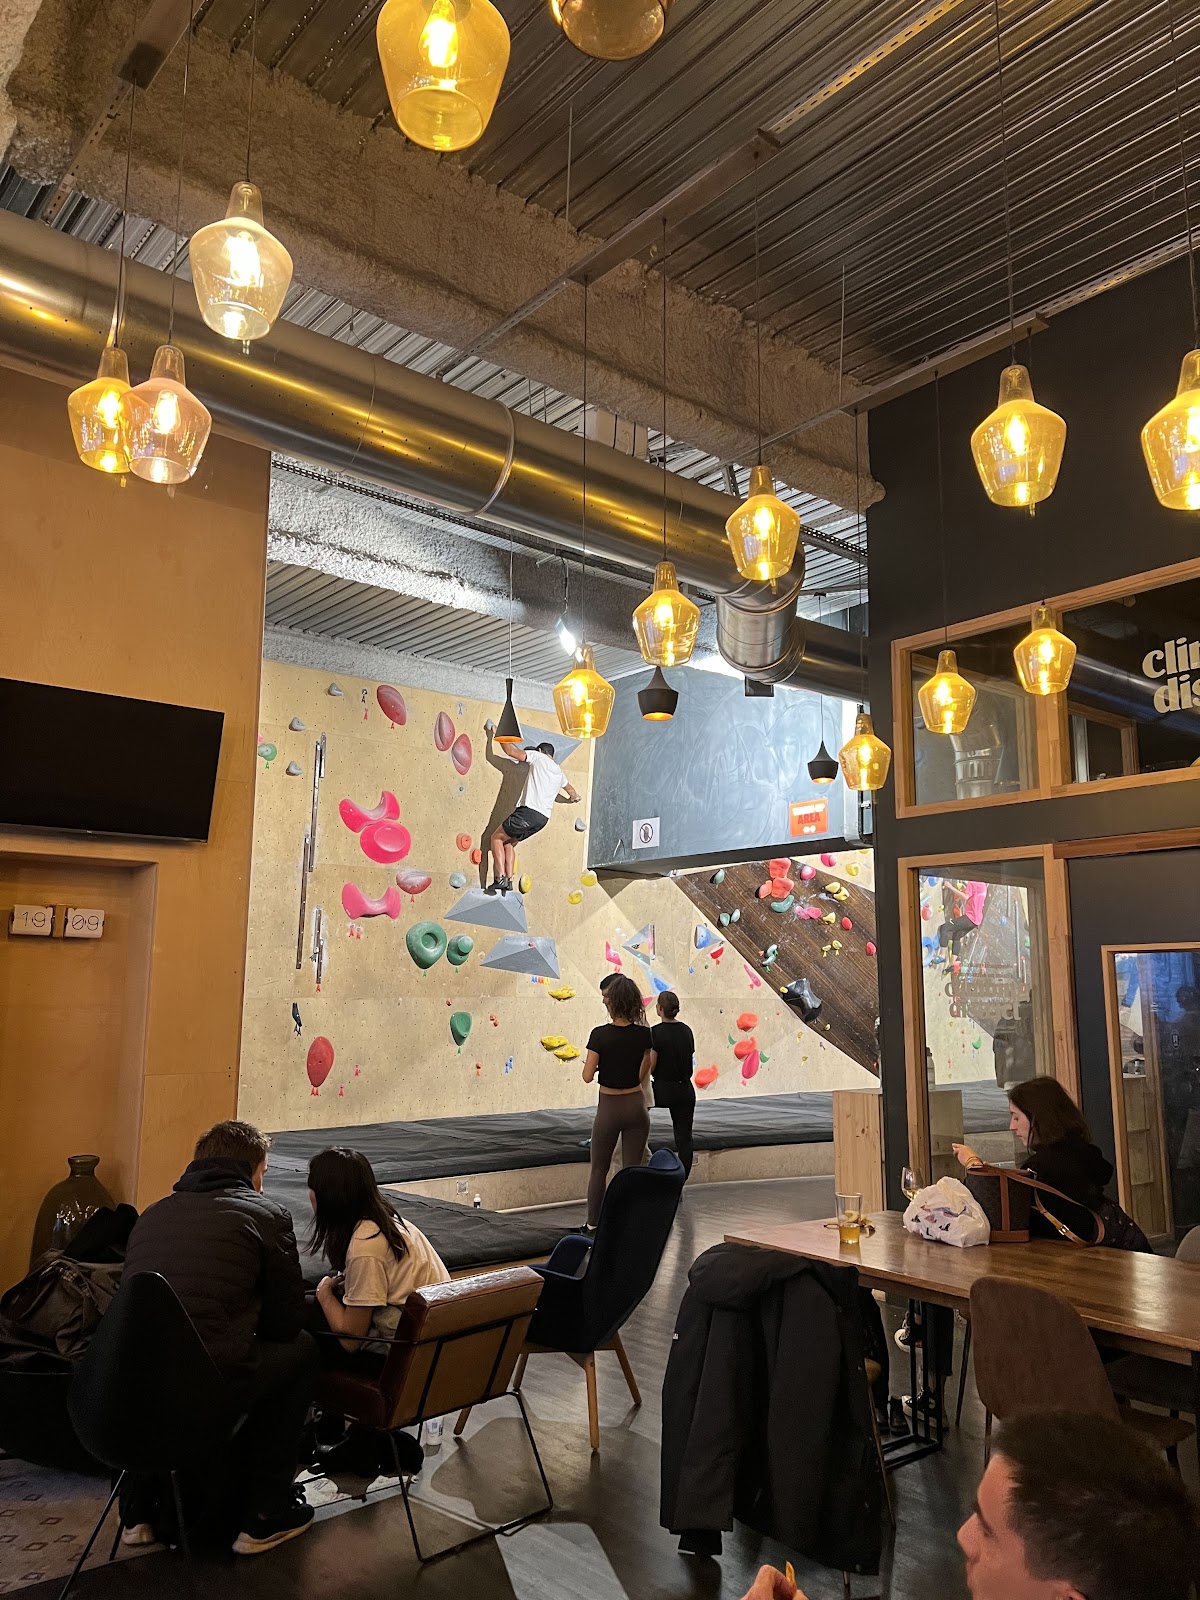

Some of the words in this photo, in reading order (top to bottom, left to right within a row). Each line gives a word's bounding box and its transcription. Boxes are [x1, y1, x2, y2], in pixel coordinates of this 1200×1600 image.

[797, 812, 821, 825] AREA
[21, 911, 46, 928] 19
[71, 914, 100, 931] 09
